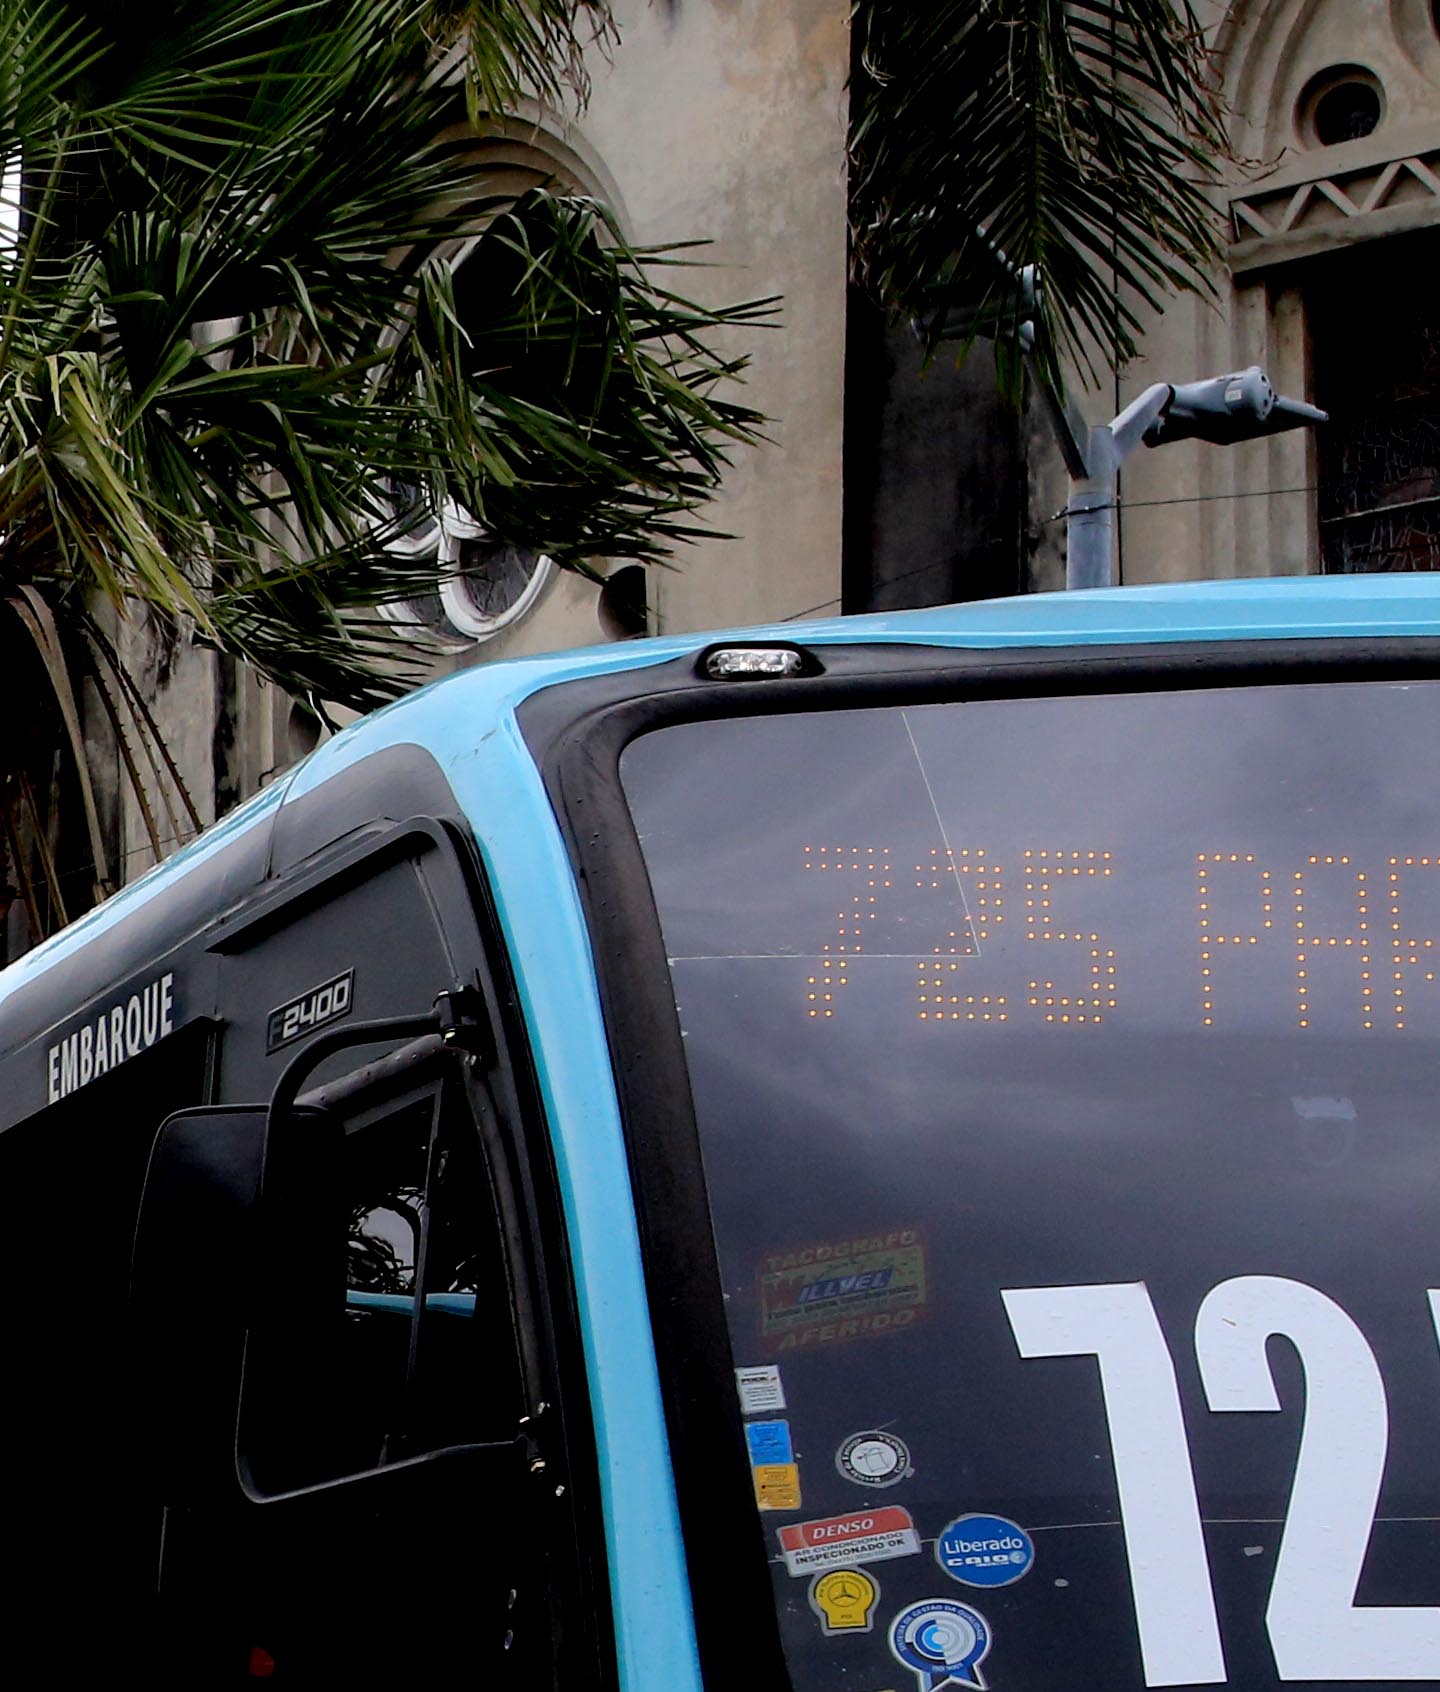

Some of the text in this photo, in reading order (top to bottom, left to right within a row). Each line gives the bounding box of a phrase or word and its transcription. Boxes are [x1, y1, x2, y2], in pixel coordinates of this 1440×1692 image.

[804, 846, 1117, 1024] 725
[48, 972, 173, 1106] EMBARQUE
[812, 1518, 874, 1539] DENSO
[795, 1542, 885, 1565] INSPECIONADO
[888, 1539, 904, 1547] OK
[944, 1536, 1023, 1554] Liberado
